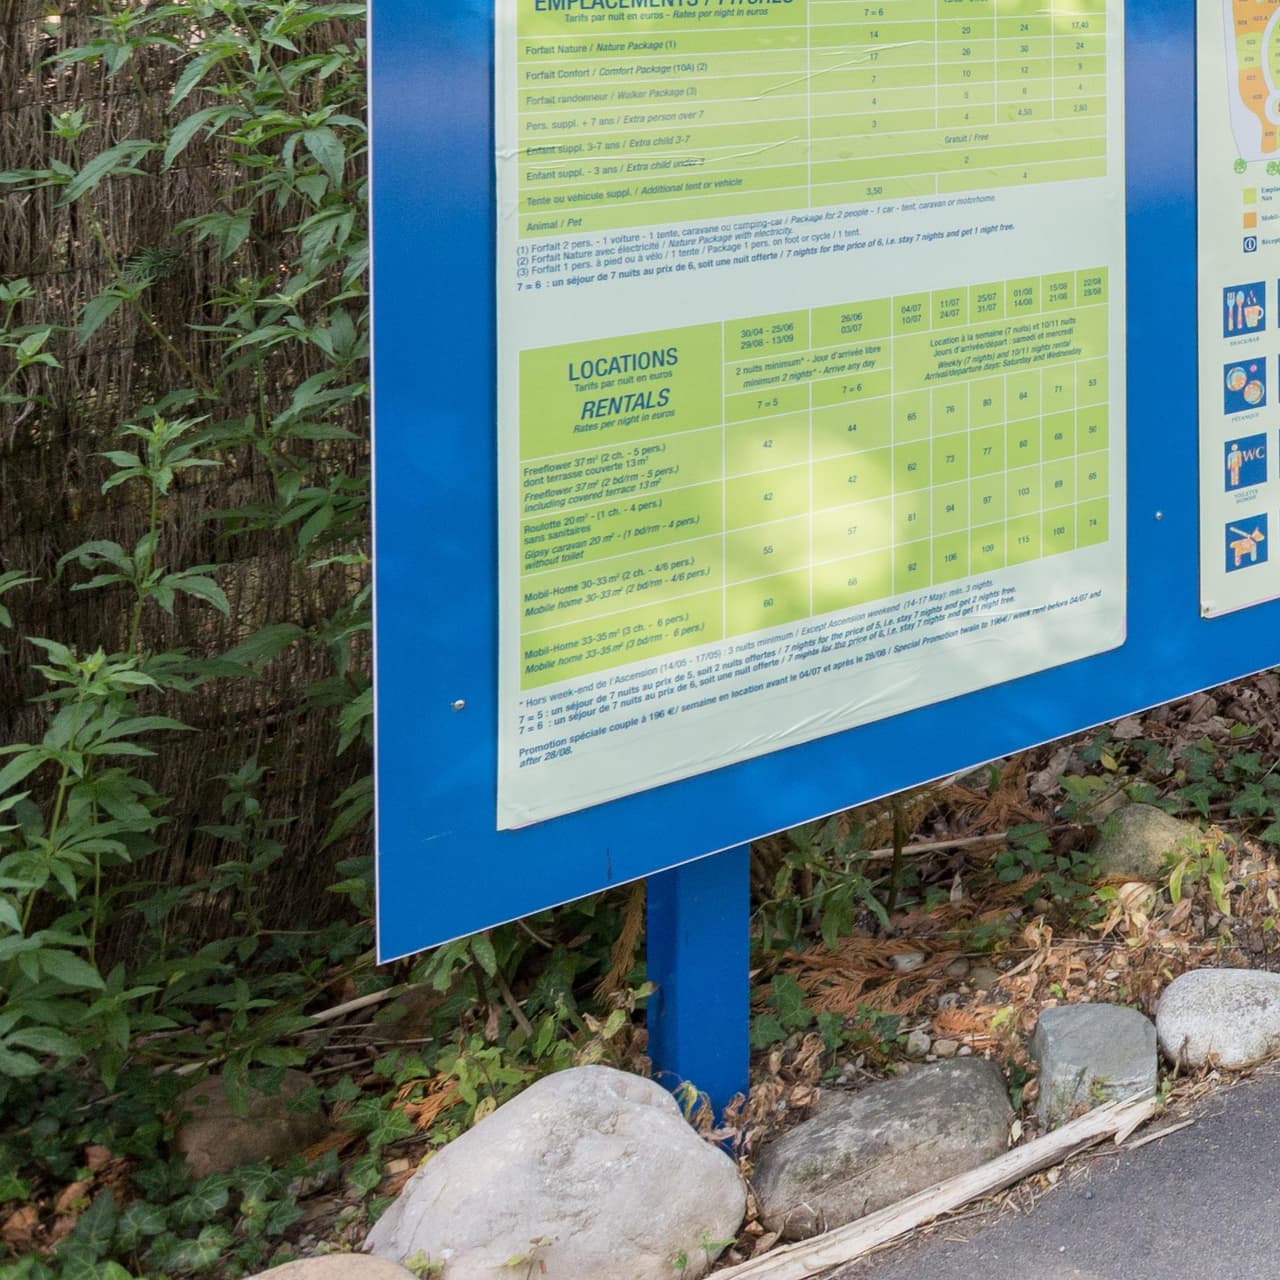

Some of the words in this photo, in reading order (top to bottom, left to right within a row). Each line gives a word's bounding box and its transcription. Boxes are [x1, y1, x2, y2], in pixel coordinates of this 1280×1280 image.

[565, 13, 589, 23] Tarifs
[592, 14, 605, 23] par
[608, 12, 625, 21] nuit
[673, 9, 697, 20] Rates
[698, 10, 712, 21] per
[714, 7, 735, 19] night
[737, 7, 745, 17] in
[747, 7, 769, 16] euros
[526, 45, 555, 55] Forfait
[557, 43, 588, 54] Nature
[596, 42, 625, 52] Nature
[627, 40, 663, 51] Package
[526, 221, 559, 232] Animal
[552, 277, 564, 288] un
[566, 273, 595, 287] séjour
[596, 271, 610, 282] de
[610, 270, 618, 281] 7
[619, 267, 642, 280] nuits
[643, 267, 656, 277] au
[656, 263, 675, 276] prix
[568, 347, 679, 382] LOCATIONS
[575, 380, 599, 393] Tarifs
[600, 379, 615, 390] par
[618, 373, 635, 386] nuit
[636, 373, 647, 383] en
[581, 387, 671, 421] RENTALS
[1242, 445, 1265, 462] WC
[519, 738, 567, 757] Promotion
